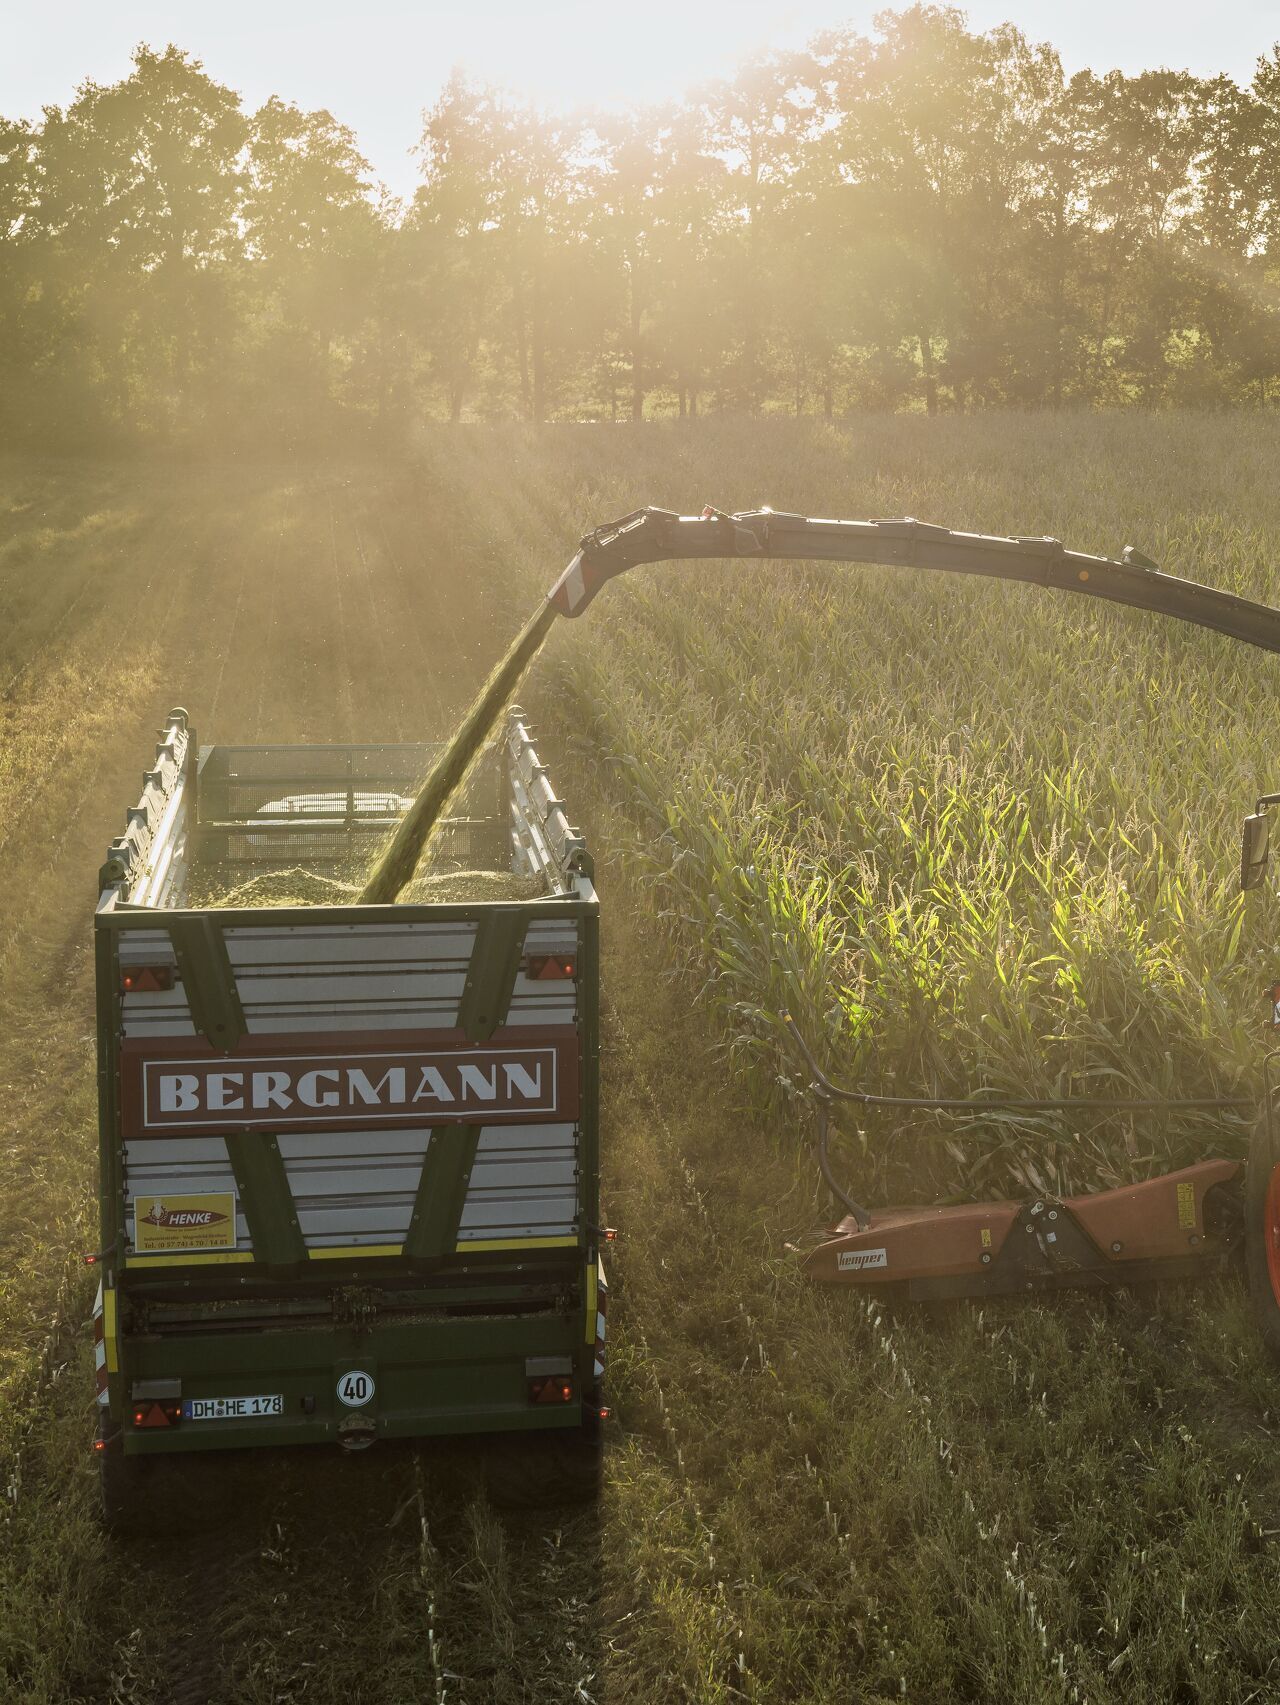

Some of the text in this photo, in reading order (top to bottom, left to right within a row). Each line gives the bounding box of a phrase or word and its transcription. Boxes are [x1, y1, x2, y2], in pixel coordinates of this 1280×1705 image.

[159, 1062, 541, 1112] BERGMANN
[169, 1212, 211, 1225] HENKE
[343, 1376, 367, 1400] 40
[193, 1398, 282, 1417] DH HE 178
